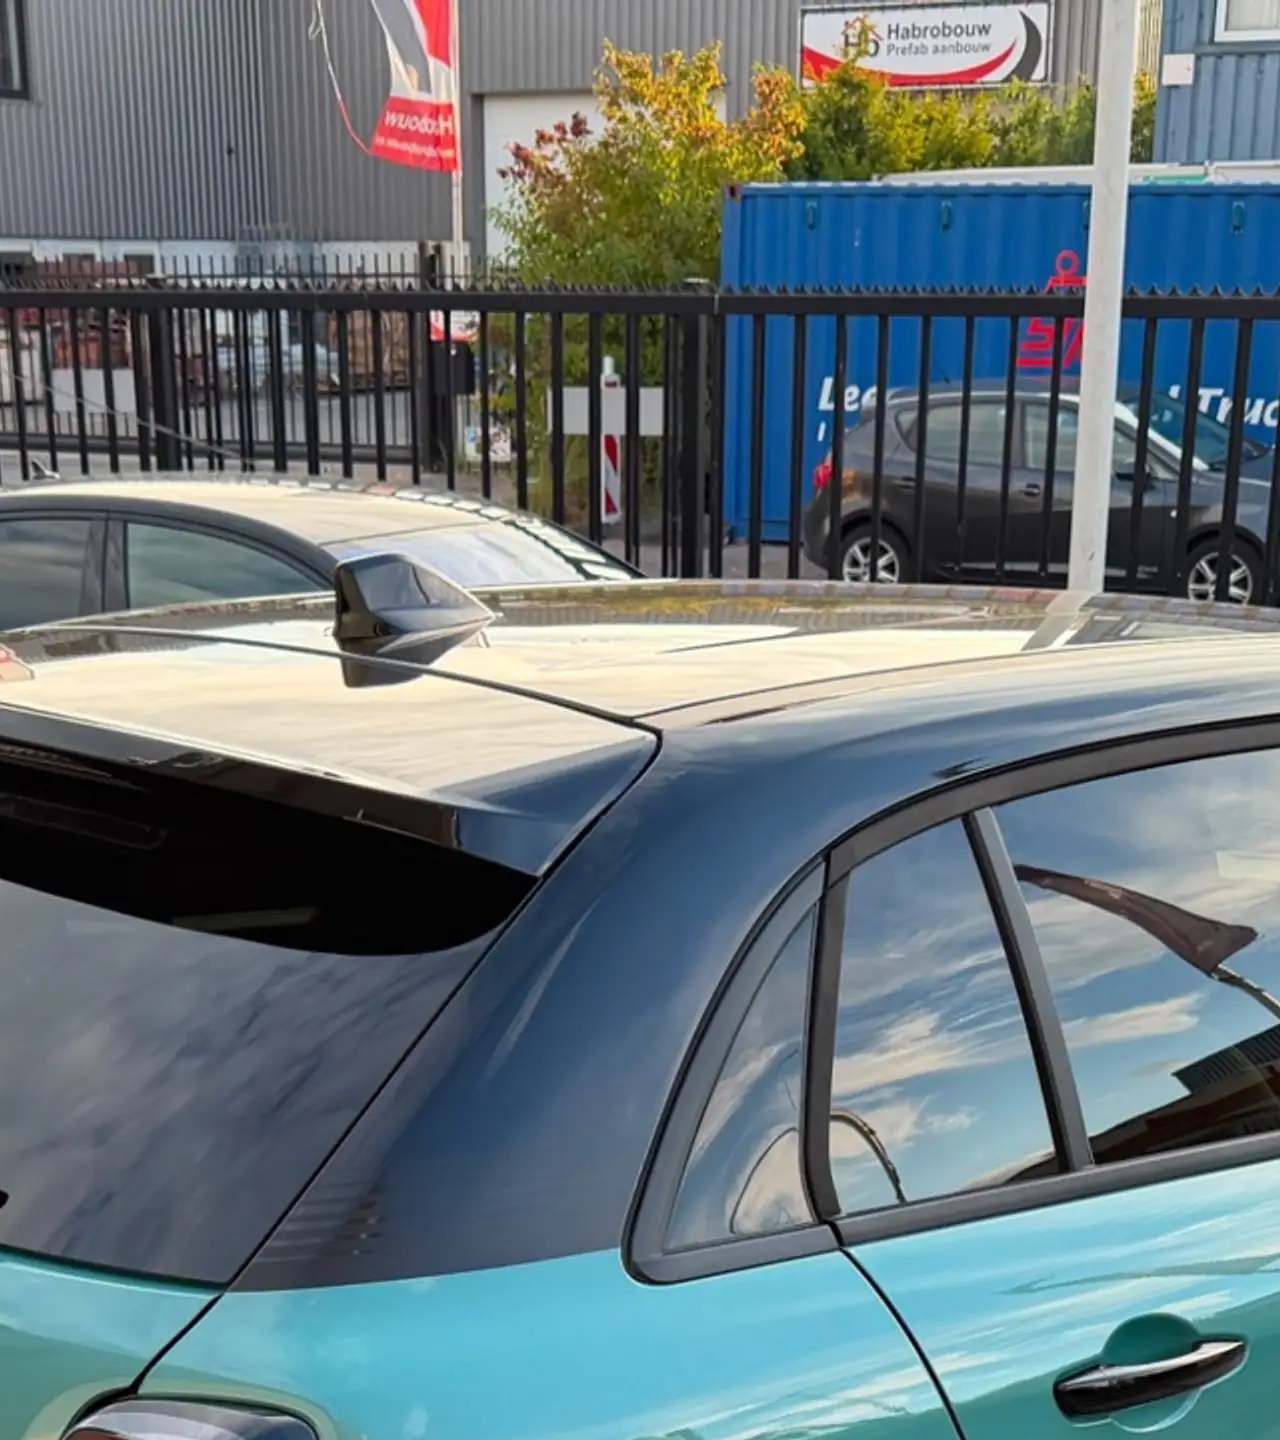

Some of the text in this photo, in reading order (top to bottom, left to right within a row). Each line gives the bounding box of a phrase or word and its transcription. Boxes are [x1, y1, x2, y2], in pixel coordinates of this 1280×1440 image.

[887, 21, 992, 40] Habrobouw
[886, 41, 992, 56] Prefab aanbouw
